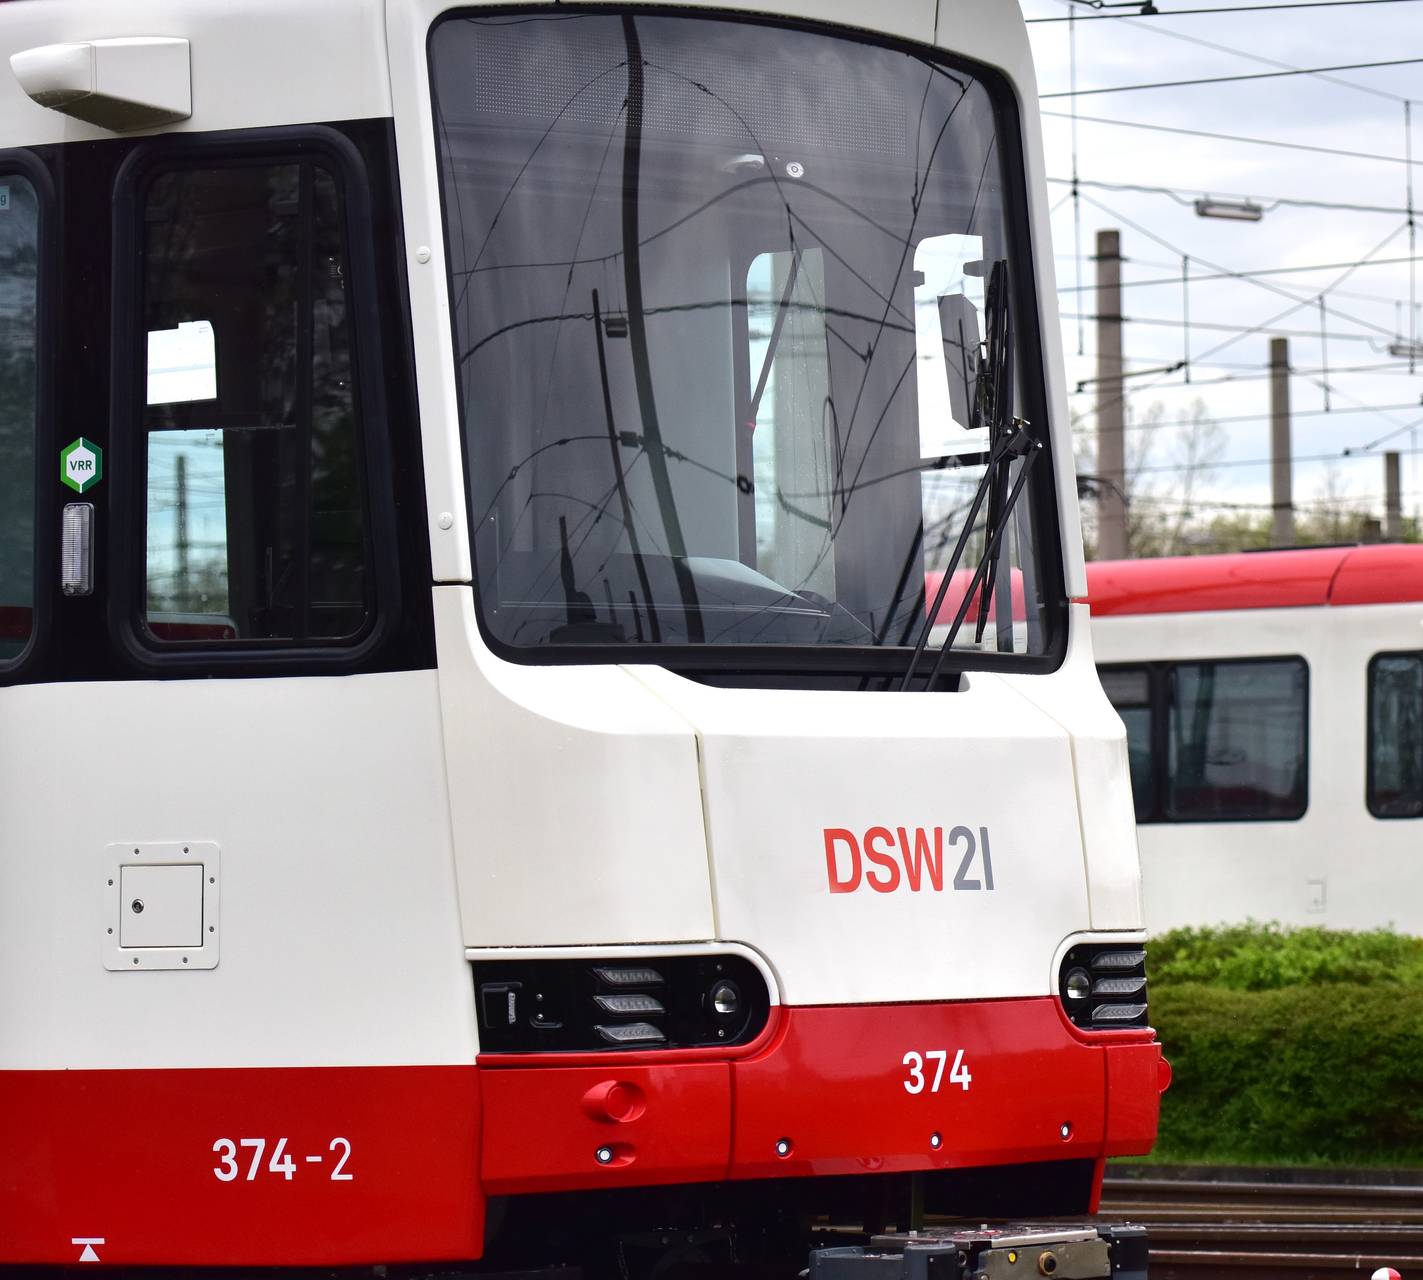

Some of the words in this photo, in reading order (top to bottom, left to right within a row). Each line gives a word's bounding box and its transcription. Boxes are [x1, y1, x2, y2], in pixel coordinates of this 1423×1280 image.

[70, 460, 92, 471] VRR
[823, 825, 995, 894] DSW21
[902, 1049, 972, 1094] 374
[212, 1137, 354, 1182] 374-2
